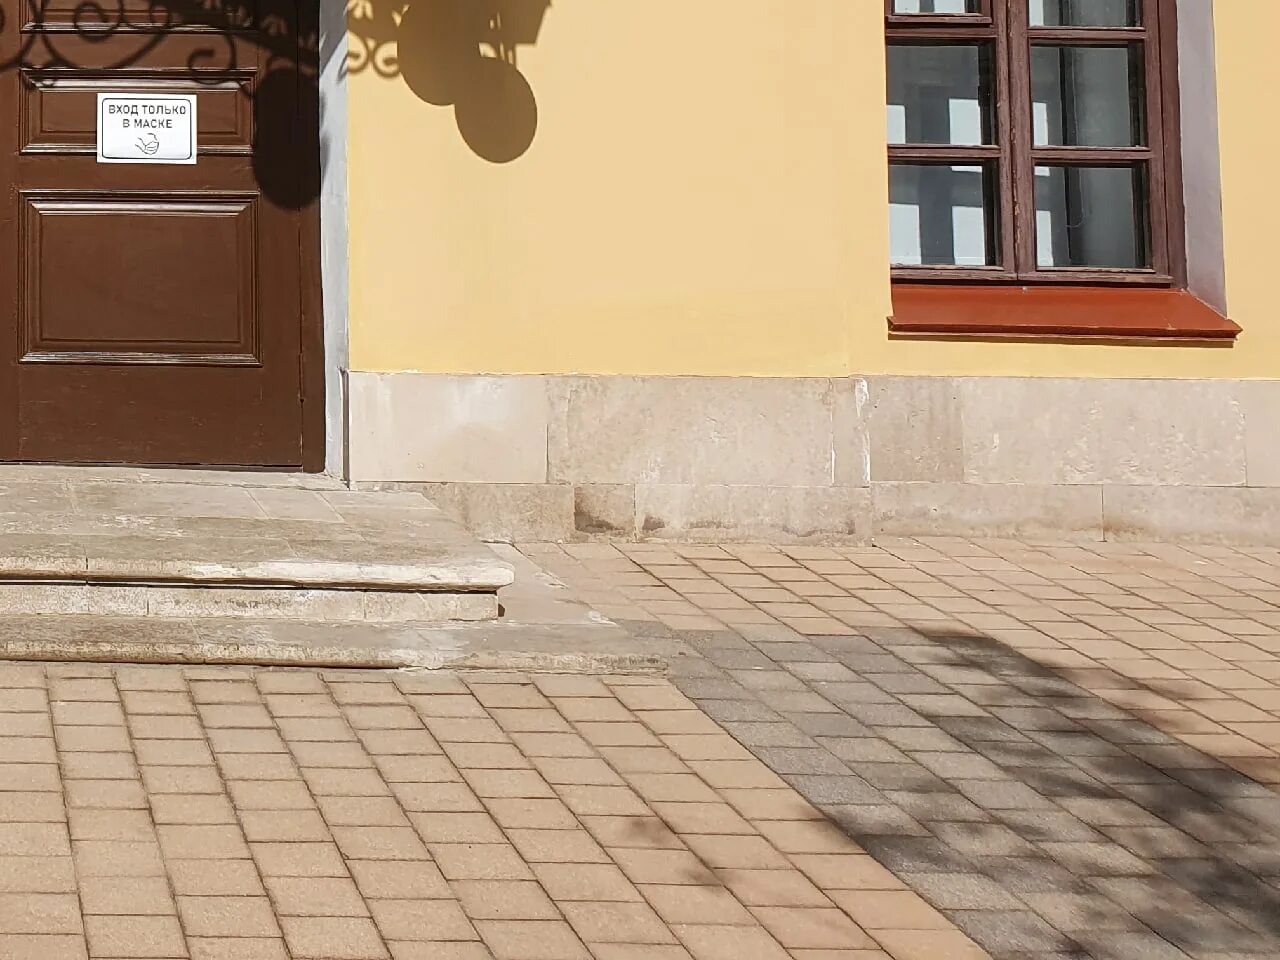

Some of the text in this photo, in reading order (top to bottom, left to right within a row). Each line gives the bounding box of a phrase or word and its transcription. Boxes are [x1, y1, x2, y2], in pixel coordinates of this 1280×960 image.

[108, 104, 187, 117] ВХОД ТОЛЬКО
[122, 118, 173, 129] В МАСКЕ
